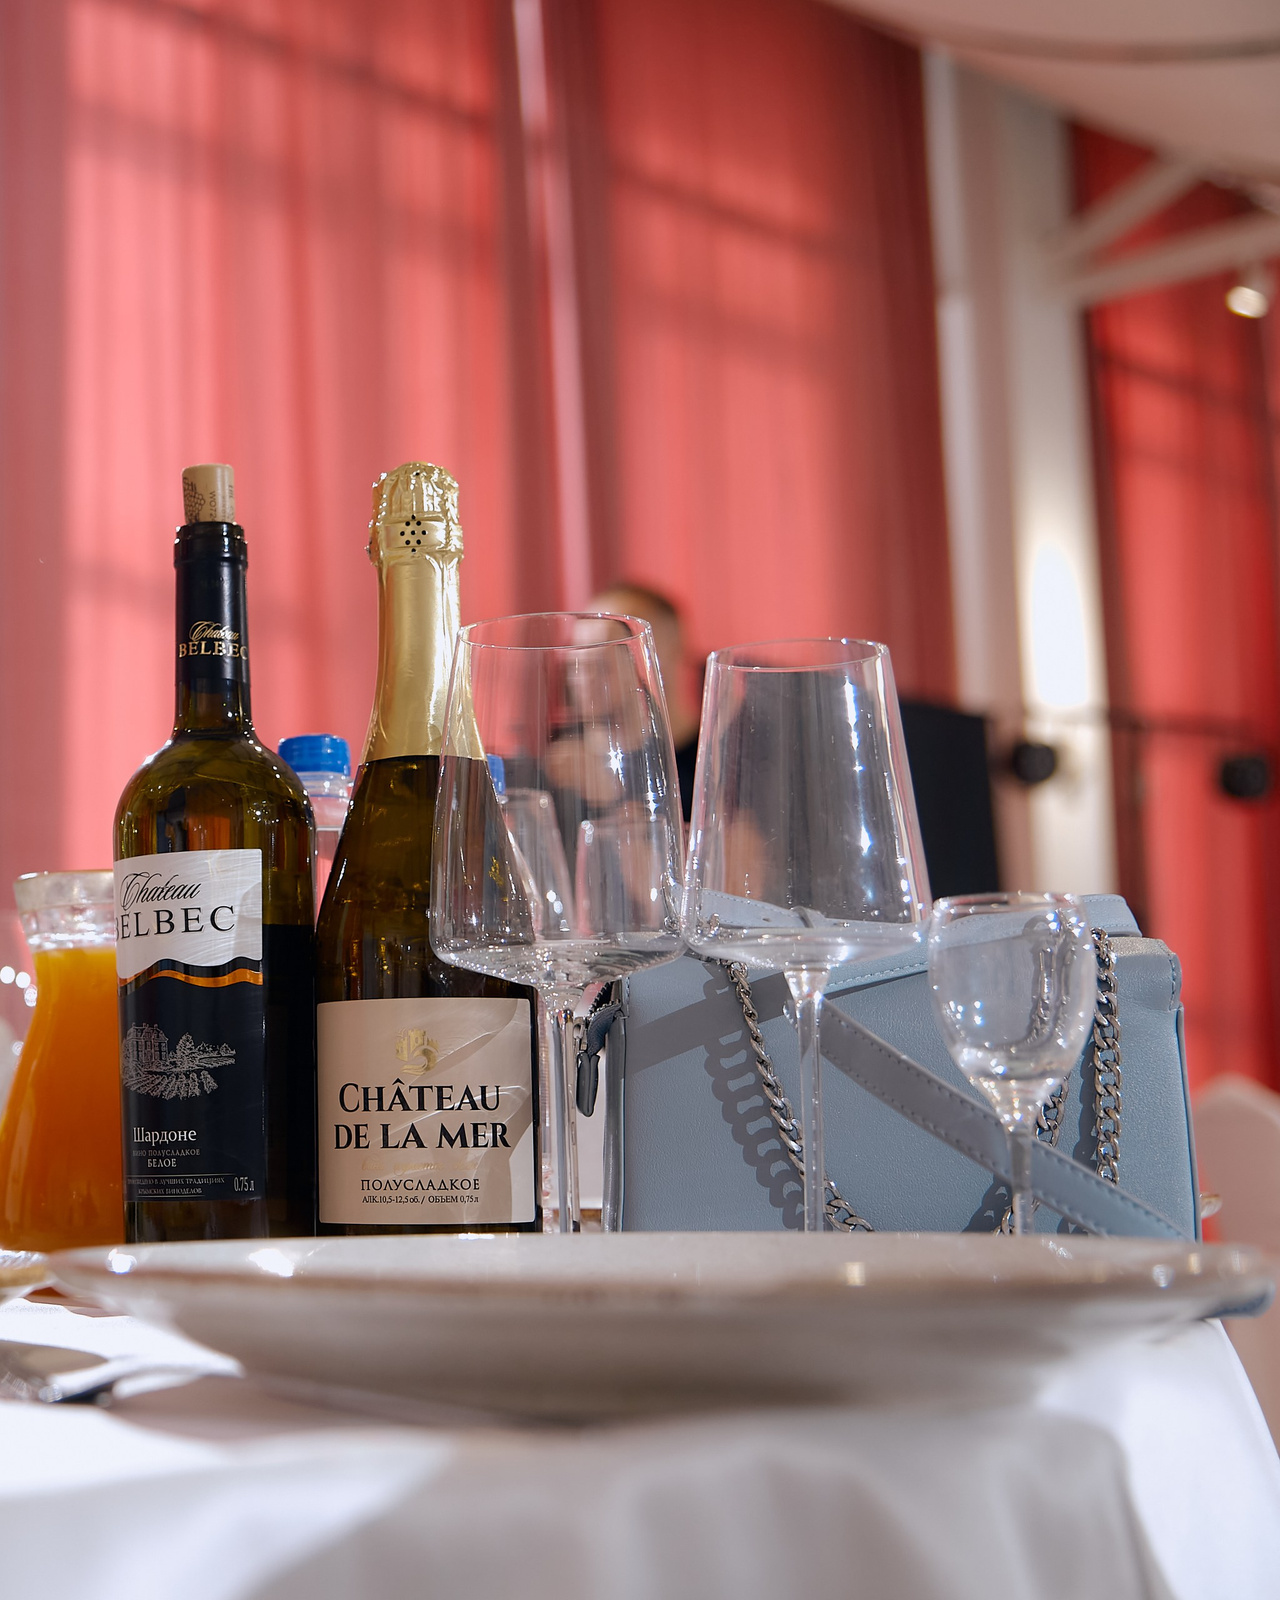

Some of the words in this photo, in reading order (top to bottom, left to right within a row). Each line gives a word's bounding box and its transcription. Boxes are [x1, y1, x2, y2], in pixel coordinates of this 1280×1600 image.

[179, 640, 247, 660] BELBEC
[120, 871, 201, 911] Chateau
[133, 1127, 197, 1147] Шардоне
[334, 1123, 370, 1150] DE
[380, 1123, 428, 1150] LA
[435, 1122, 511, 1149] MER
[148, 1148, 201, 1157] ПОЛУСЛАДКОЕ
[147, 1158, 177, 1168] БЕЛОЕ
[360, 1178, 480, 1191] ПОЛУСЛАДКОЕ
[428, 1195, 459, 1204] ОБЪЕМ
